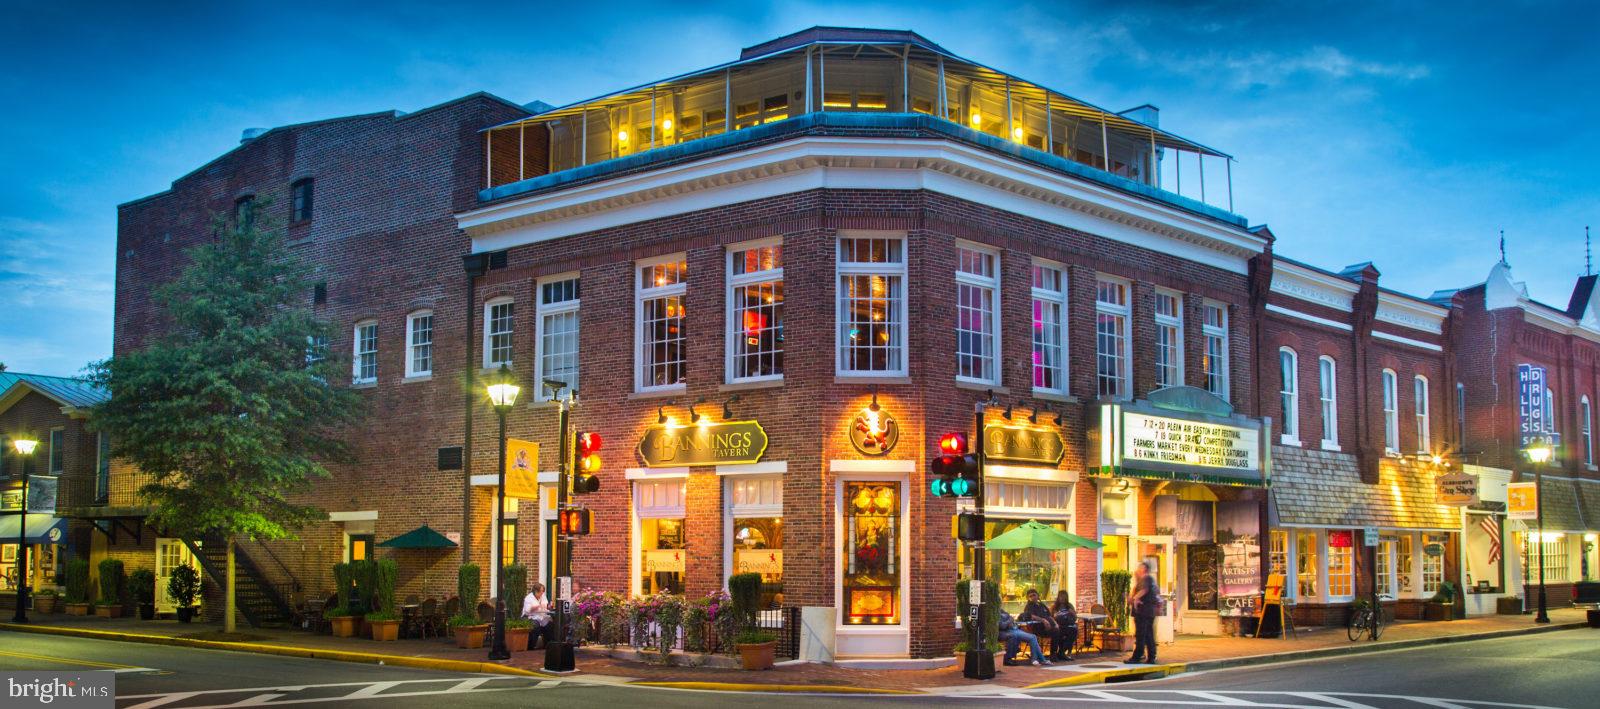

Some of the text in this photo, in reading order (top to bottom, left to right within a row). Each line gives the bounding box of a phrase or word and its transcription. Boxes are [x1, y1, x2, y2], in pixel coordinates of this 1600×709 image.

[1520, 371, 1529, 432] HILL'S
[1532, 371, 1540, 432] DRUGS
[1167, 422, 1182, 431] PLEIN
[1183, 424, 1192, 432] AIR
[1193, 425, 1211, 435] EASTON
[1212, 428, 1221, 436] ART
[1221, 429, 1241, 439] FESTIVAL
[654, 432, 751, 461] BANNINGS
[1168, 433, 1182, 441] QUICK
[1203, 437, 1233, 447] COMPETITION
[713, 448, 749, 457] TAVERN
[1133, 438, 1155, 449] FARMERS
[1157, 441, 1178, 451] MARKET
[1179, 443, 1193, 453] EVERY
[1195, 445, 1222, 456] WEDNESDAY
[1226, 449, 1249, 459] SATURDAY
[1144, 449, 1159, 459] KINKY
[1161, 451, 1186, 462] FRIEDMAN
[1208, 457, 1224, 466] JERRY
[1225, 458, 1249, 468] DOUGLASS
[1456, 485, 1477, 495] Shop
